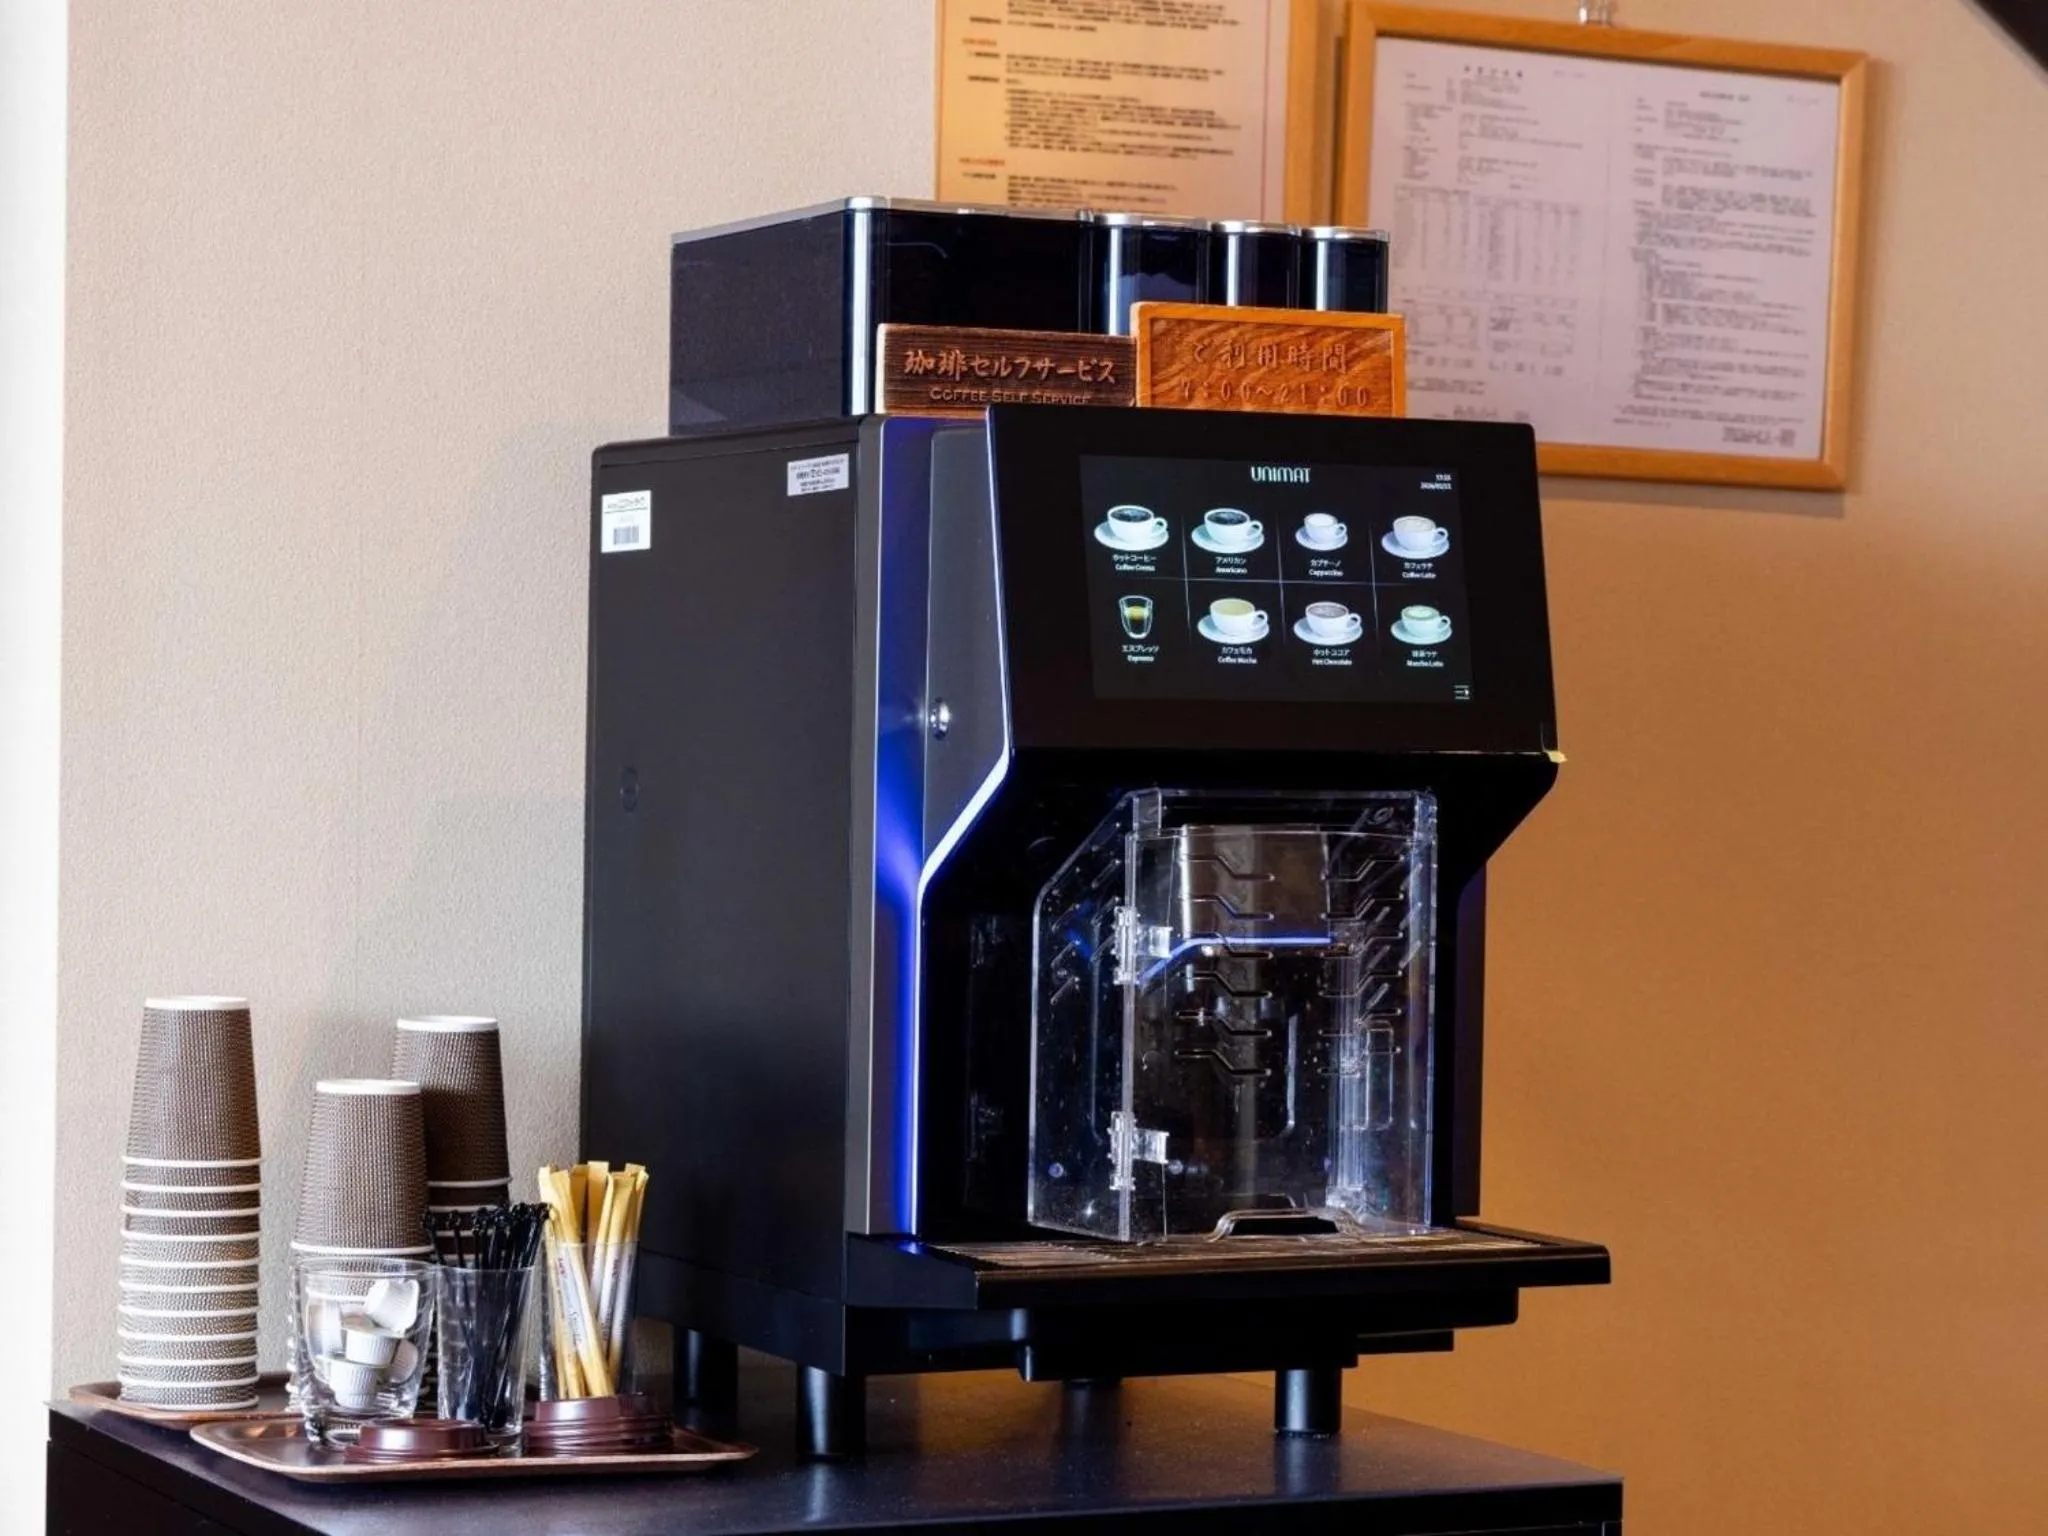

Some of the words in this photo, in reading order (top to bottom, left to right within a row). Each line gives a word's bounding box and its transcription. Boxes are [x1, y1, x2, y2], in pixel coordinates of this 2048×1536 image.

[904, 349, 1115, 384] 珈琲セルフサービス
[1251, 466, 1311, 483] UNIMAT
